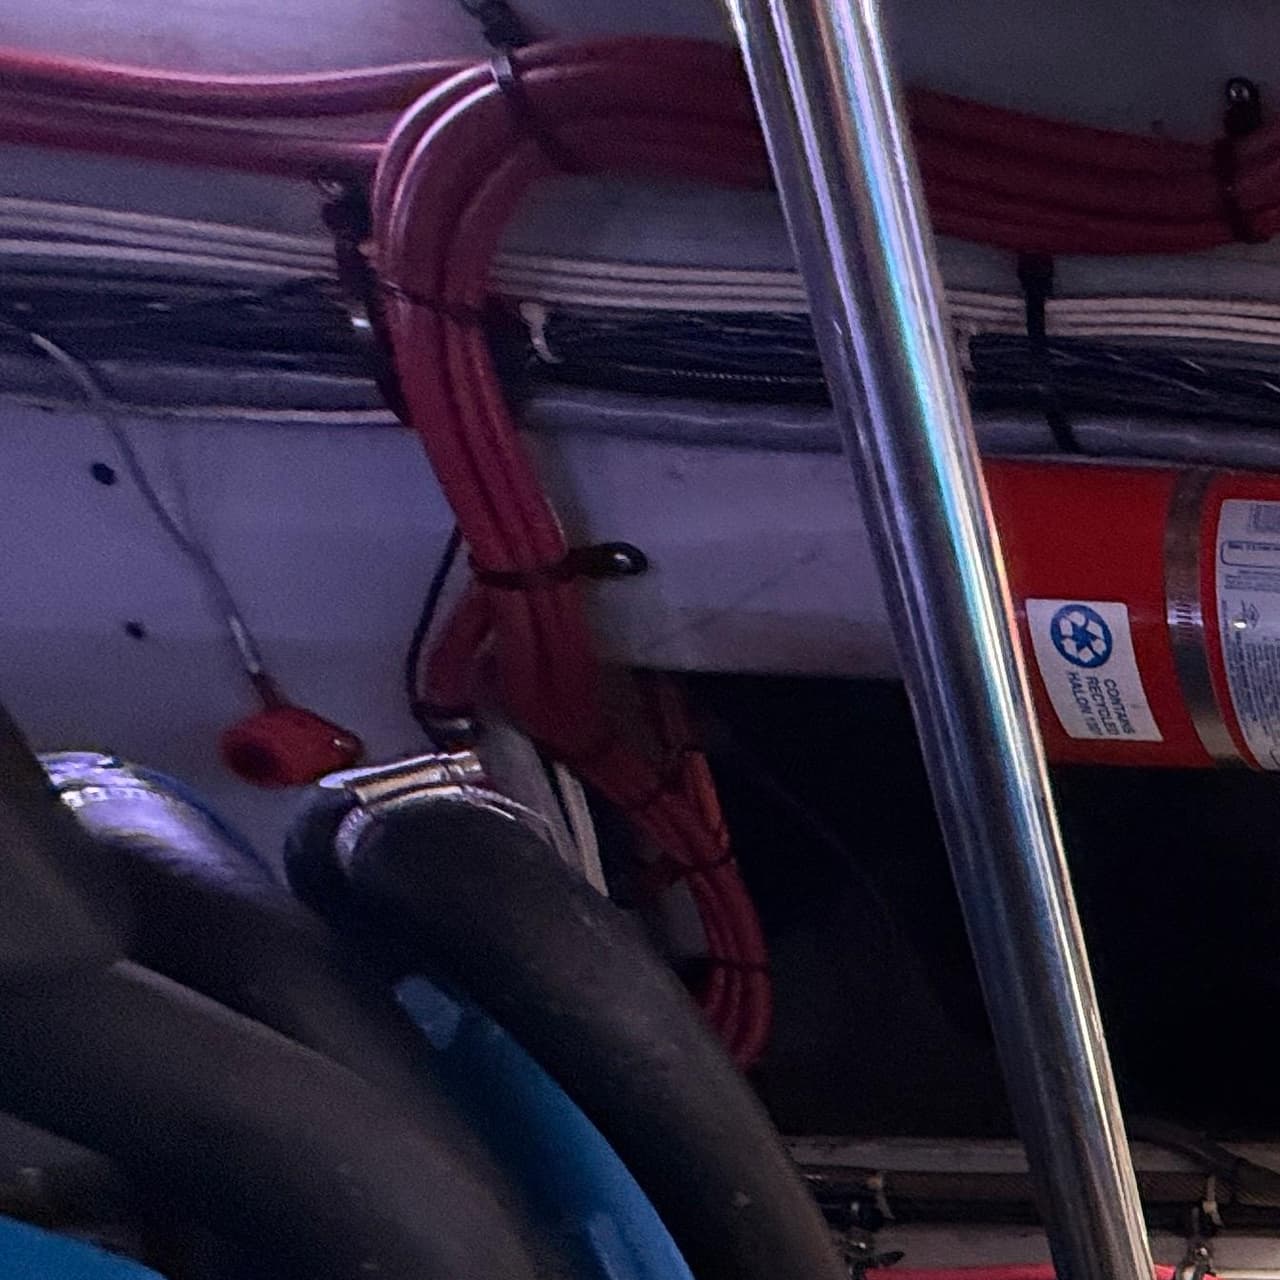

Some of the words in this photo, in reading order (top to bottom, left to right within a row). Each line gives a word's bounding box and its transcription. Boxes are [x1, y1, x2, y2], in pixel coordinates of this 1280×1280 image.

[1067, 671, 1093, 714] HALON
[1085, 676, 1120, 735] RECYCLED
[1103, 678, 1136, 734] CONTAINS
